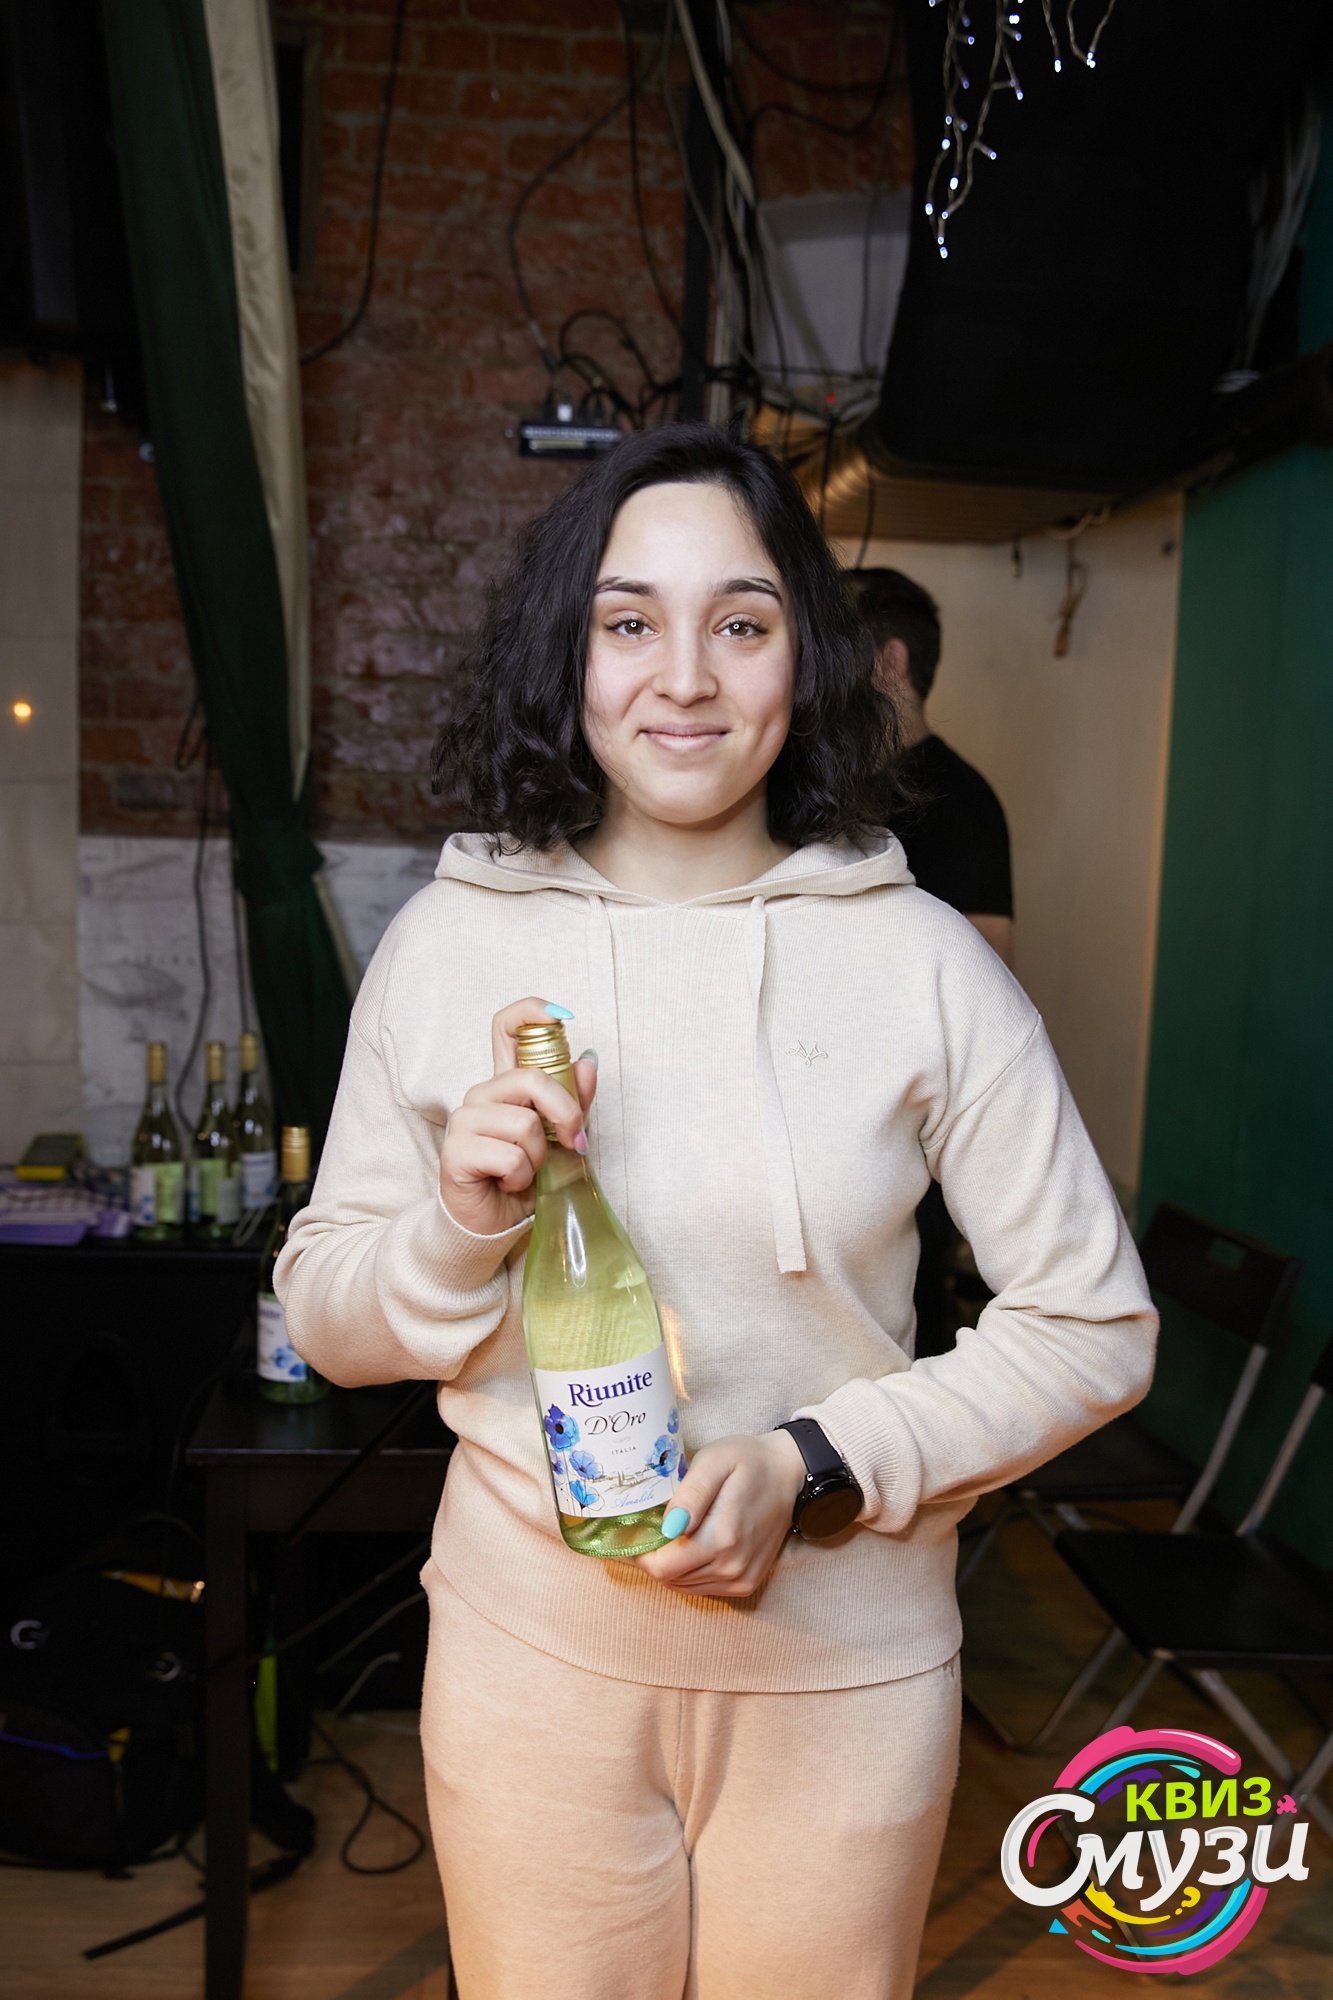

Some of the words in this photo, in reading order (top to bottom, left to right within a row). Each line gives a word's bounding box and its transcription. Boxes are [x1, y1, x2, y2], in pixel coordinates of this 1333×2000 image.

[568, 1371, 652, 1407] Riunite
[584, 1410, 646, 1436] D'Oro
[611, 1446, 637, 1455] ITALIA
